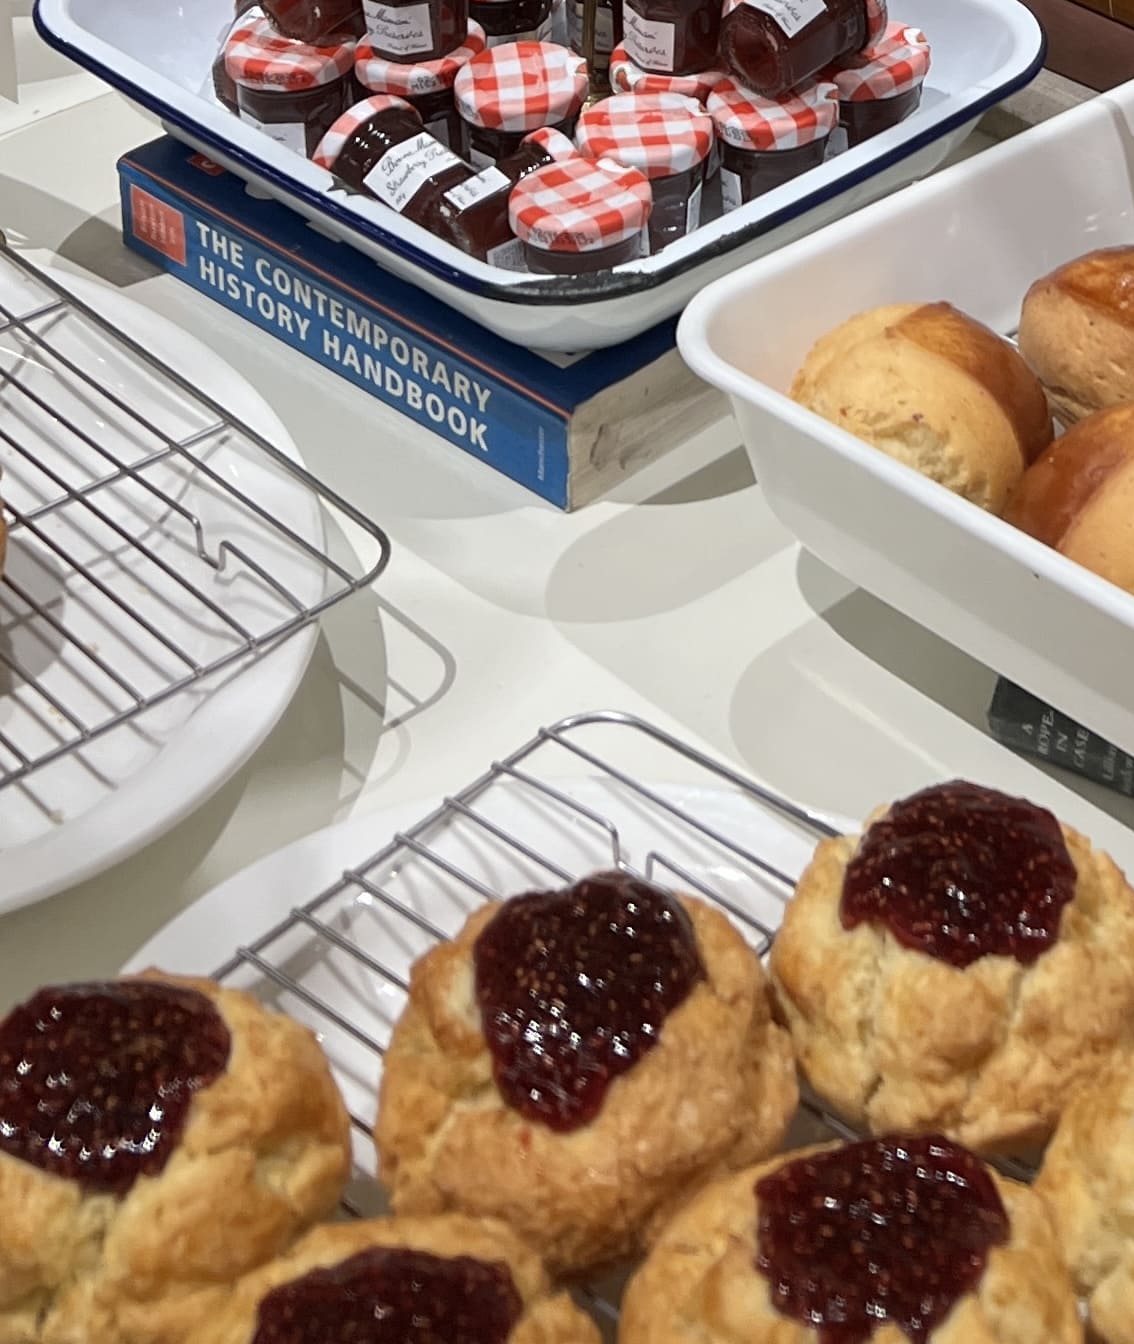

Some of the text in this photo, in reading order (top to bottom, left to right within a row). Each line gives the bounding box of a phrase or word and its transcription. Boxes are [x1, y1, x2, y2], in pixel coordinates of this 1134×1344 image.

[195, 220, 246, 270] THE
[254, 252, 494, 413] CONTEMPORARY
[198, 254, 490, 453] HISTORY HANDBOOK
[1021, 722, 1033, 735] A
[1037, 710, 1055, 755] ROPE
[1056, 731, 1068, 752] IN
[1074, 729, 1090, 769] CASE
